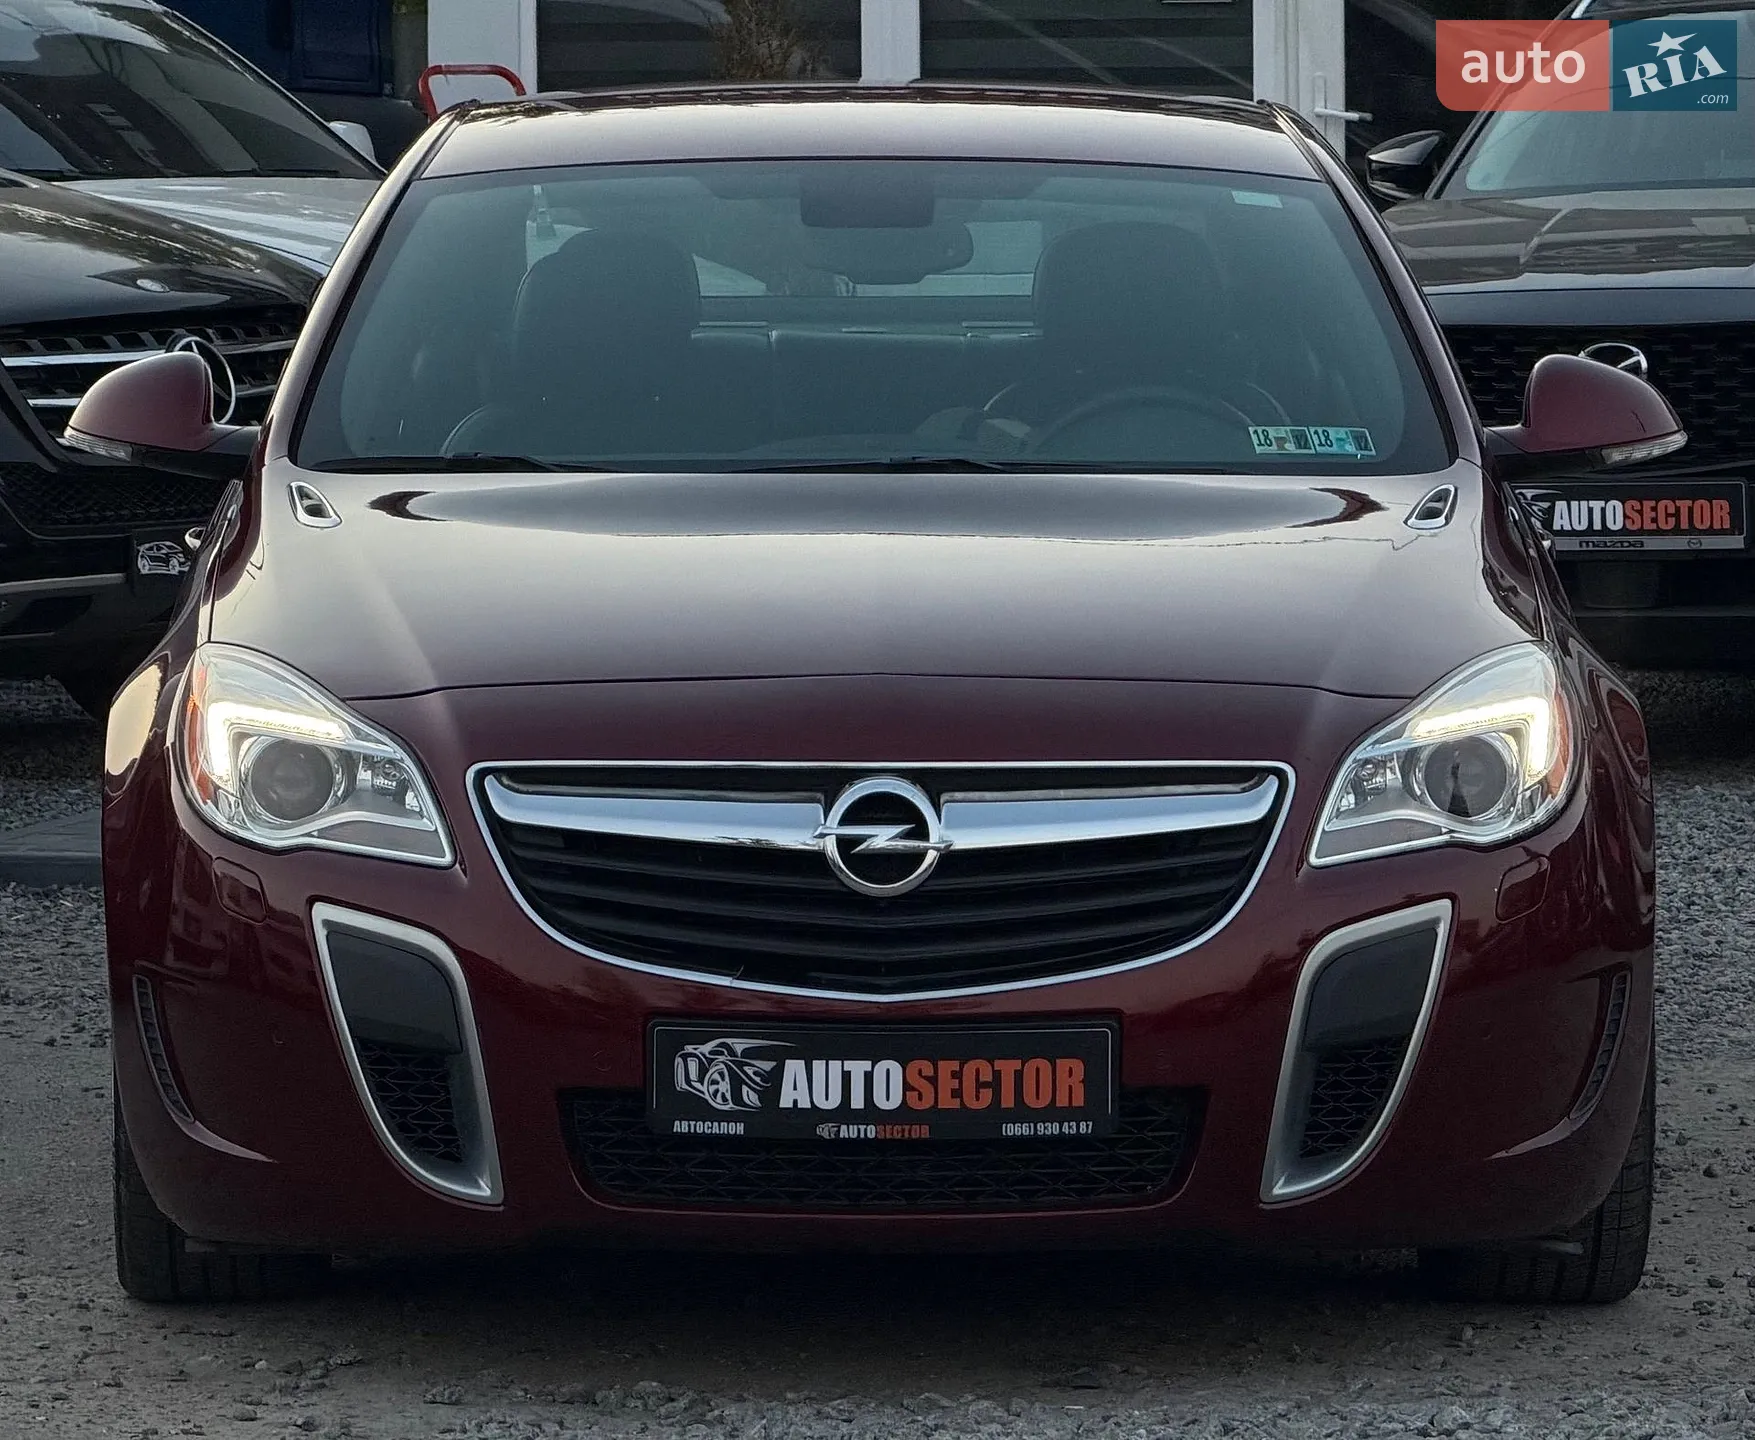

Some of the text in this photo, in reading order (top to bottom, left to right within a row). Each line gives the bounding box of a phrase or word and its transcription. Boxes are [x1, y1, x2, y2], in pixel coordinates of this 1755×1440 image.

[1252, 429, 1273, 448] 18
[1313, 429, 1334, 448] 18
[1552, 499, 1731, 531] AUTOSECTOR
[778, 1058, 1085, 1110] AUTOSECTOR
[673, 1120, 745, 1135] АВТОСАЛОН
[839, 1124, 930, 1139] AUTOSECTOR
[1002, 1121, 1093, 1136] (066) 930 43 87
